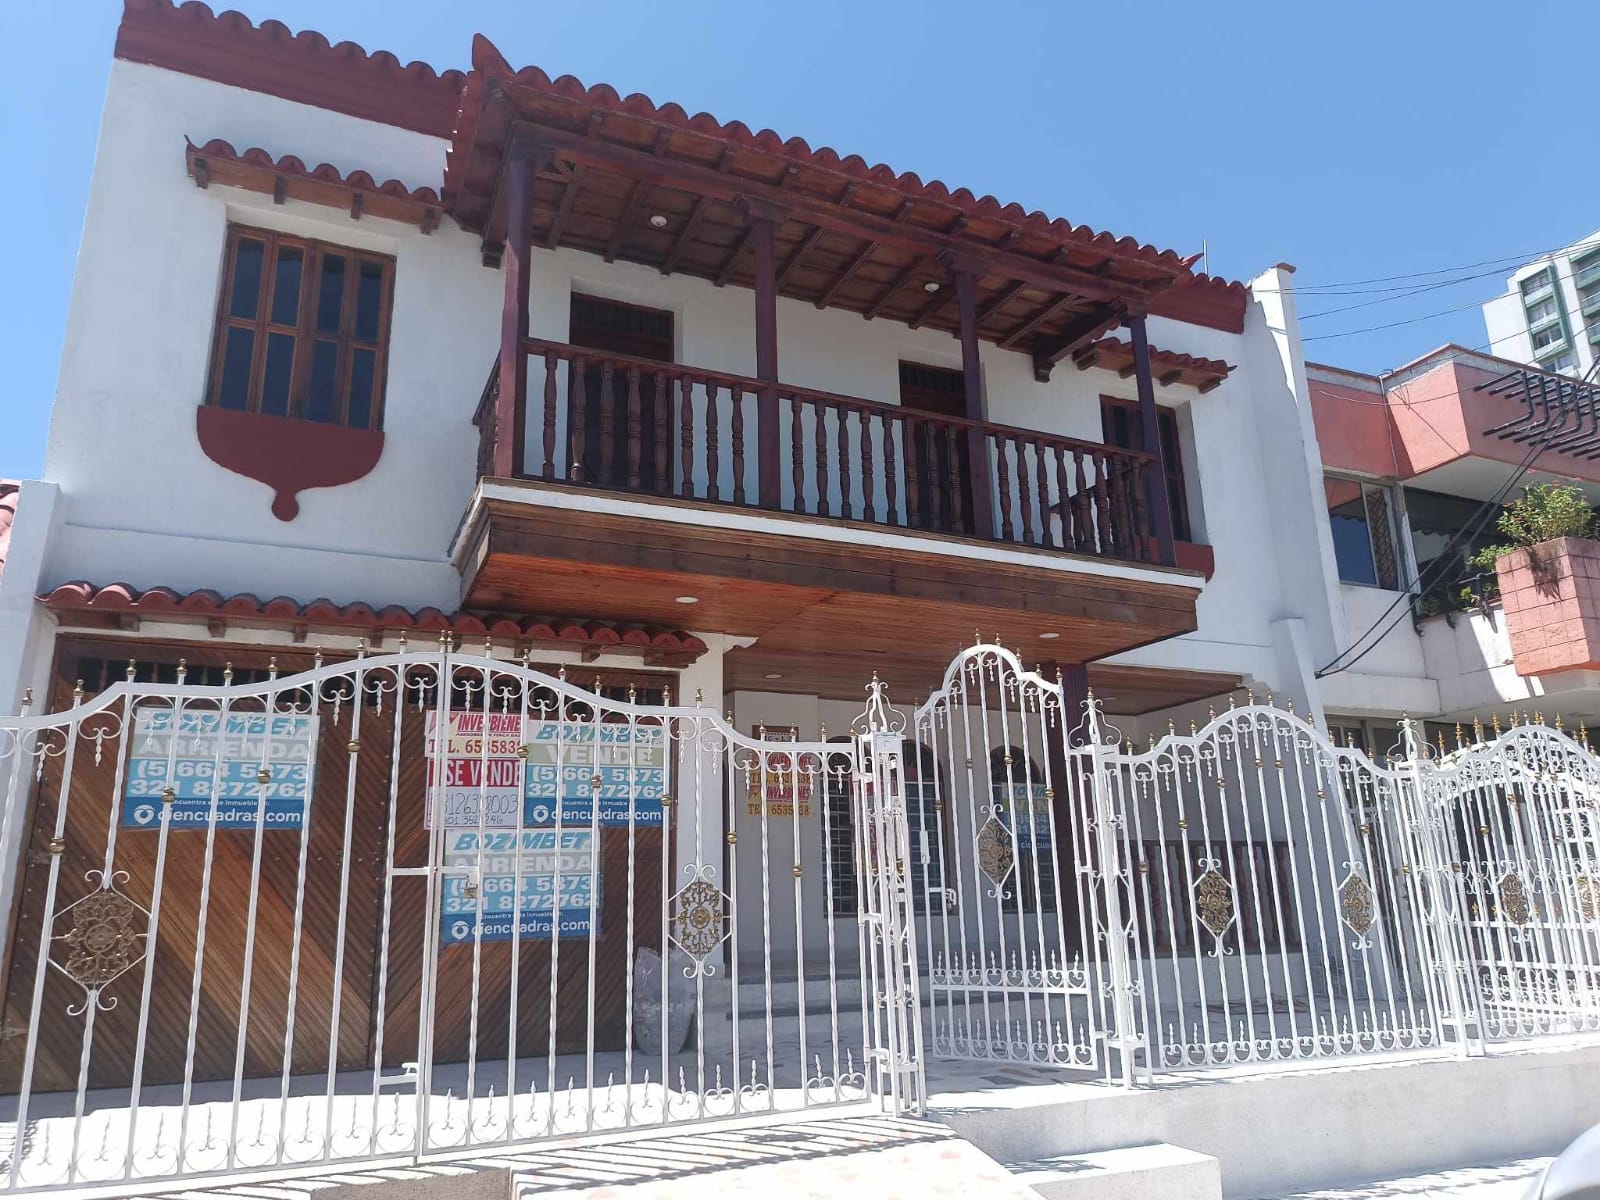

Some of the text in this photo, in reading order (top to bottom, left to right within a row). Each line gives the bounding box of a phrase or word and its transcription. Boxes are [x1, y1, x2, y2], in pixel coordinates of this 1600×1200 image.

[457, 714, 522, 731] INVEBIENE
[429, 739, 460, 753] TL.
[546, 744, 653, 764] VENDE
[471, 760, 522, 786] VNDE
[771, 804, 809, 815] 653538
